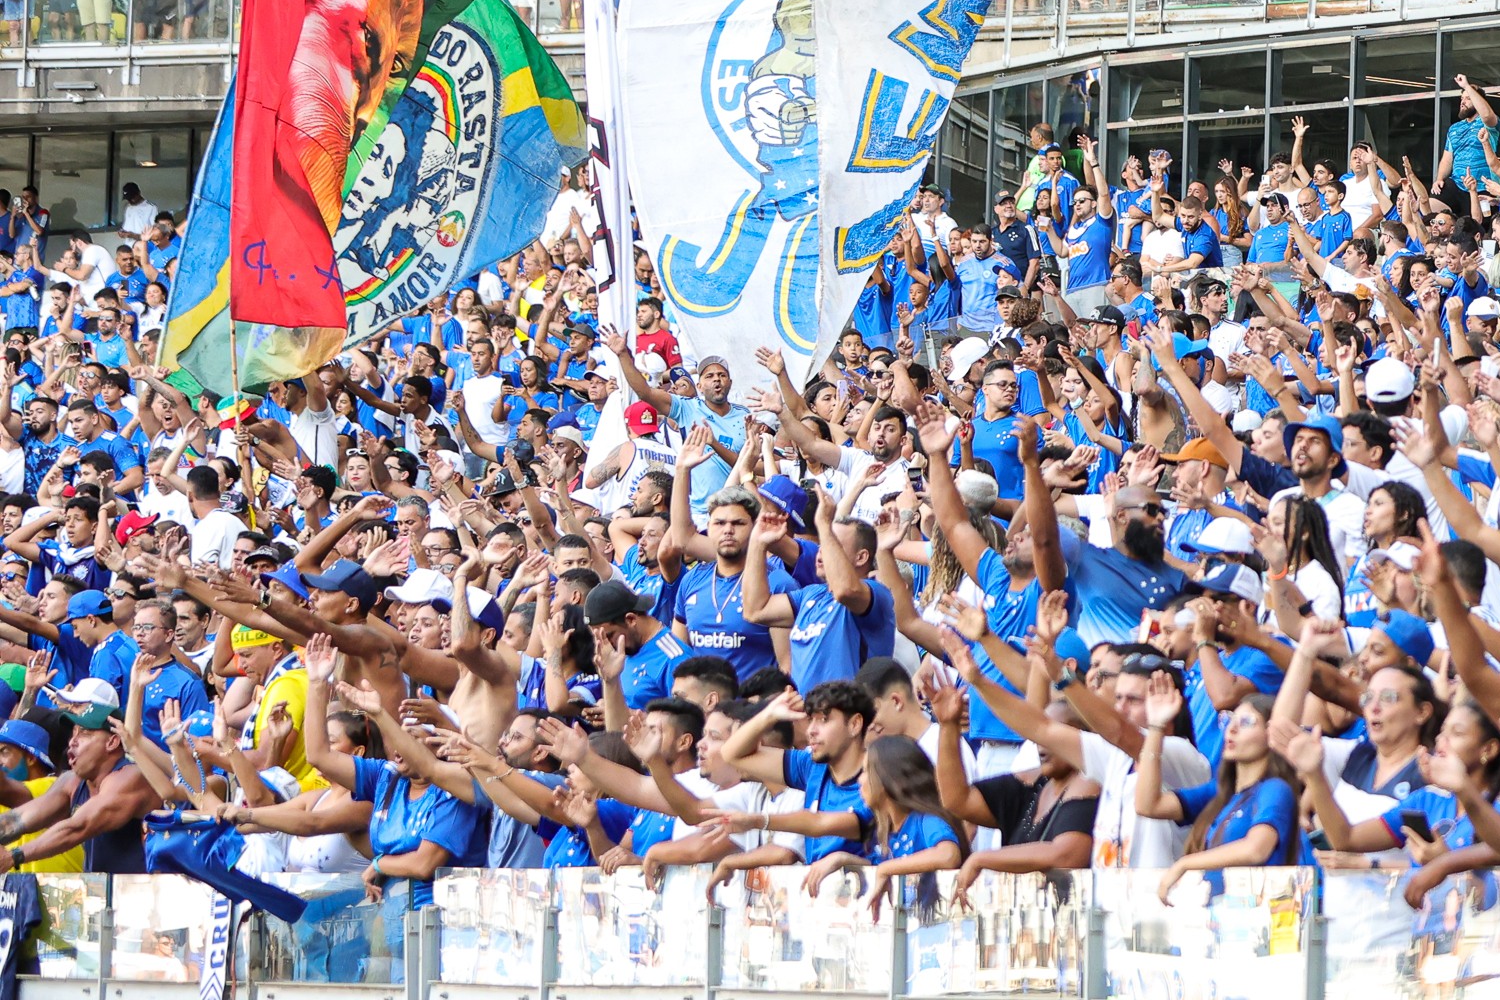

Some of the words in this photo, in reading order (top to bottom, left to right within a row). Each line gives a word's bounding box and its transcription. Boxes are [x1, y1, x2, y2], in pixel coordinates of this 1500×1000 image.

[429, 31, 468, 67] DO
[453, 61, 487, 202] RASTA
[368, 251, 447, 331] AMOR
